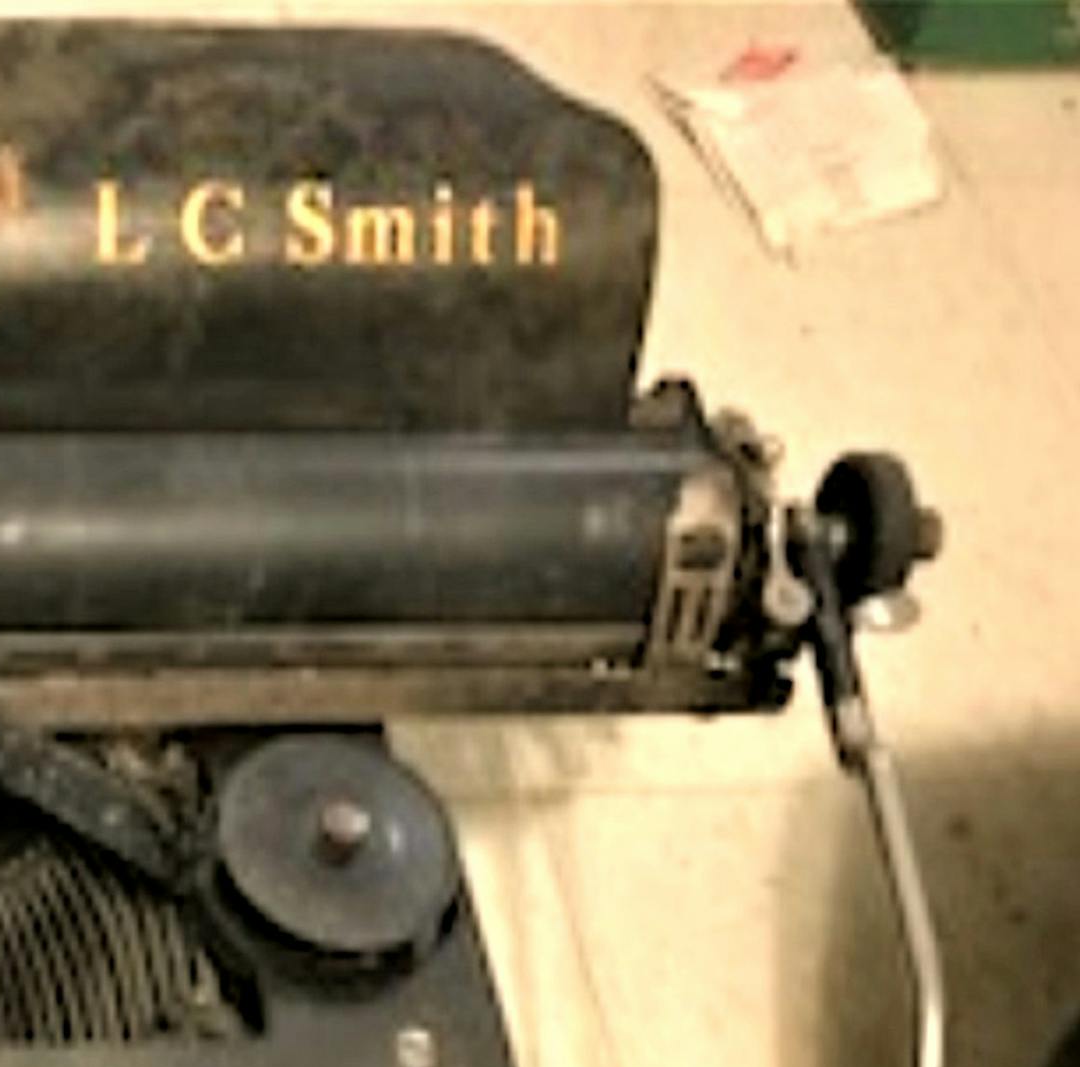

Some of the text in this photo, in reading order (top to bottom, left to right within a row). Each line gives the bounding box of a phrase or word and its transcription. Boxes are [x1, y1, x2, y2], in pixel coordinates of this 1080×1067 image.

[94, 180, 560, 266] L C Smith
